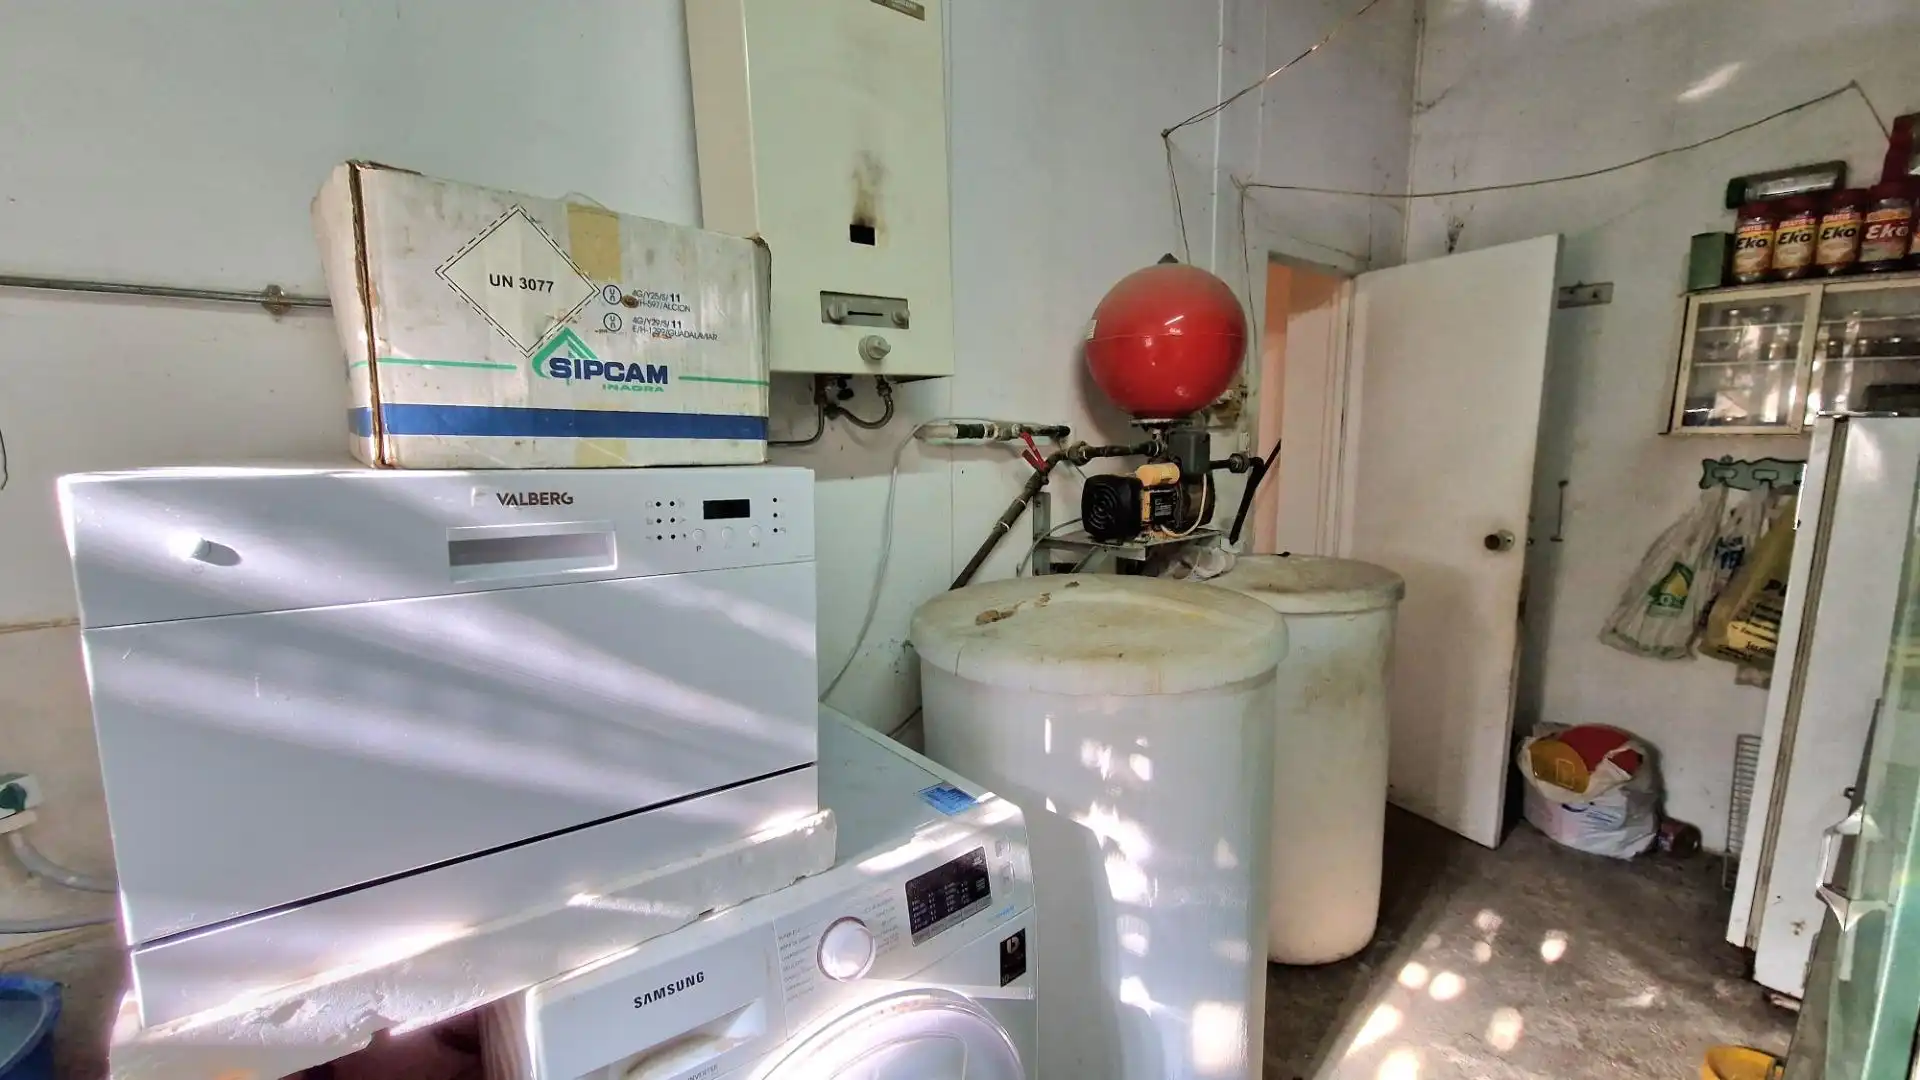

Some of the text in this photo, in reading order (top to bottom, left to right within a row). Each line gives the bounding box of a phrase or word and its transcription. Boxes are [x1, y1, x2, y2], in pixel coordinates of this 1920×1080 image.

[1778, 230, 1811, 245] Eko
[1821, 226, 1857, 241] Eko
[1865, 224, 1908, 240] Eko
[1735, 237, 1768, 250] Eko
[489, 273, 554, 293] UN 3077
[548, 357, 668, 385] SIPCAM
[496, 491, 574, 506] VALBERG
[633, 970, 705, 1009] SAMSUNG
